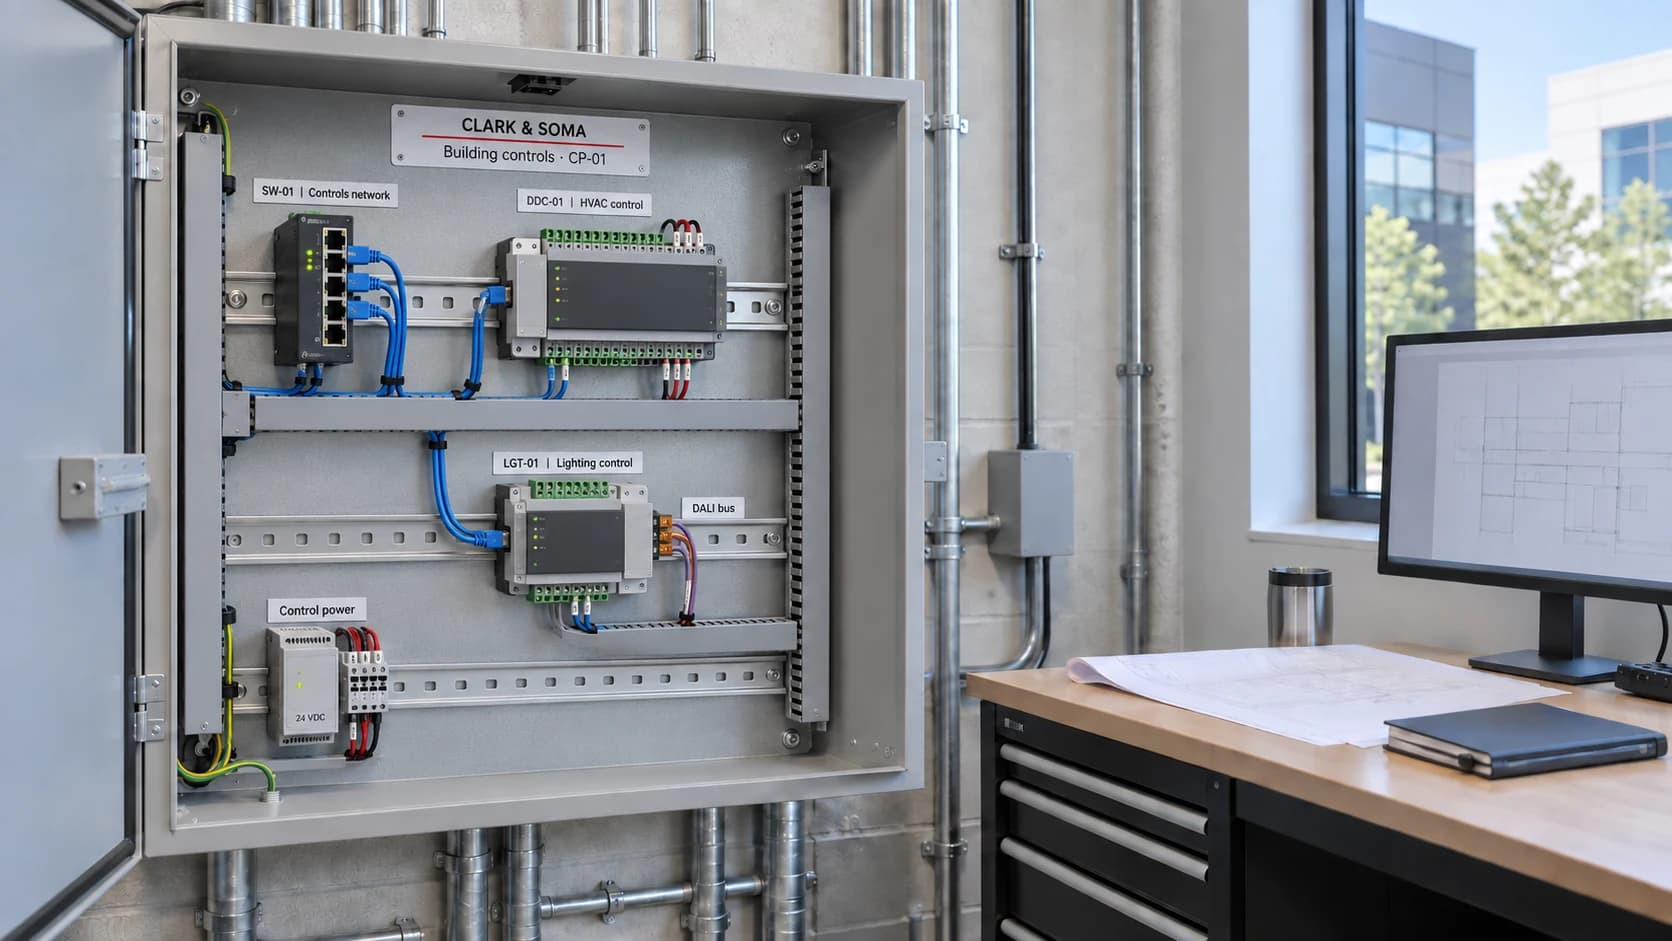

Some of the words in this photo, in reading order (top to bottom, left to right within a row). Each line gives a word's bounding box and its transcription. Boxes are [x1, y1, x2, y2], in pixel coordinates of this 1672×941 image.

[461, 117, 517, 135] CLARK
[521, 120, 533, 136] &
[538, 121, 587, 138] SOMA
[443, 144, 498, 164] Building
[502, 149, 555, 163] controls
[568, 151, 606, 166] CP-01
[261, 185, 294, 197] SW-01
[308, 187, 350, 199] Controls
[351, 189, 391, 201] network
[526, 195, 563, 207] DDC-01
[580, 197, 608, 209] HVAC
[610, 199, 644, 210] control
[503, 457, 538, 469] LGT-01
[556, 457, 597, 471] Lighting
[598, 457, 633, 468] control
[692, 503, 715, 513] DALI
[717, 503, 736, 513] bus
[279, 604, 319, 617] Control
[322, 606, 356, 618] power
[295, 714, 306, 722] 24
[307, 713, 326, 722] VDC
